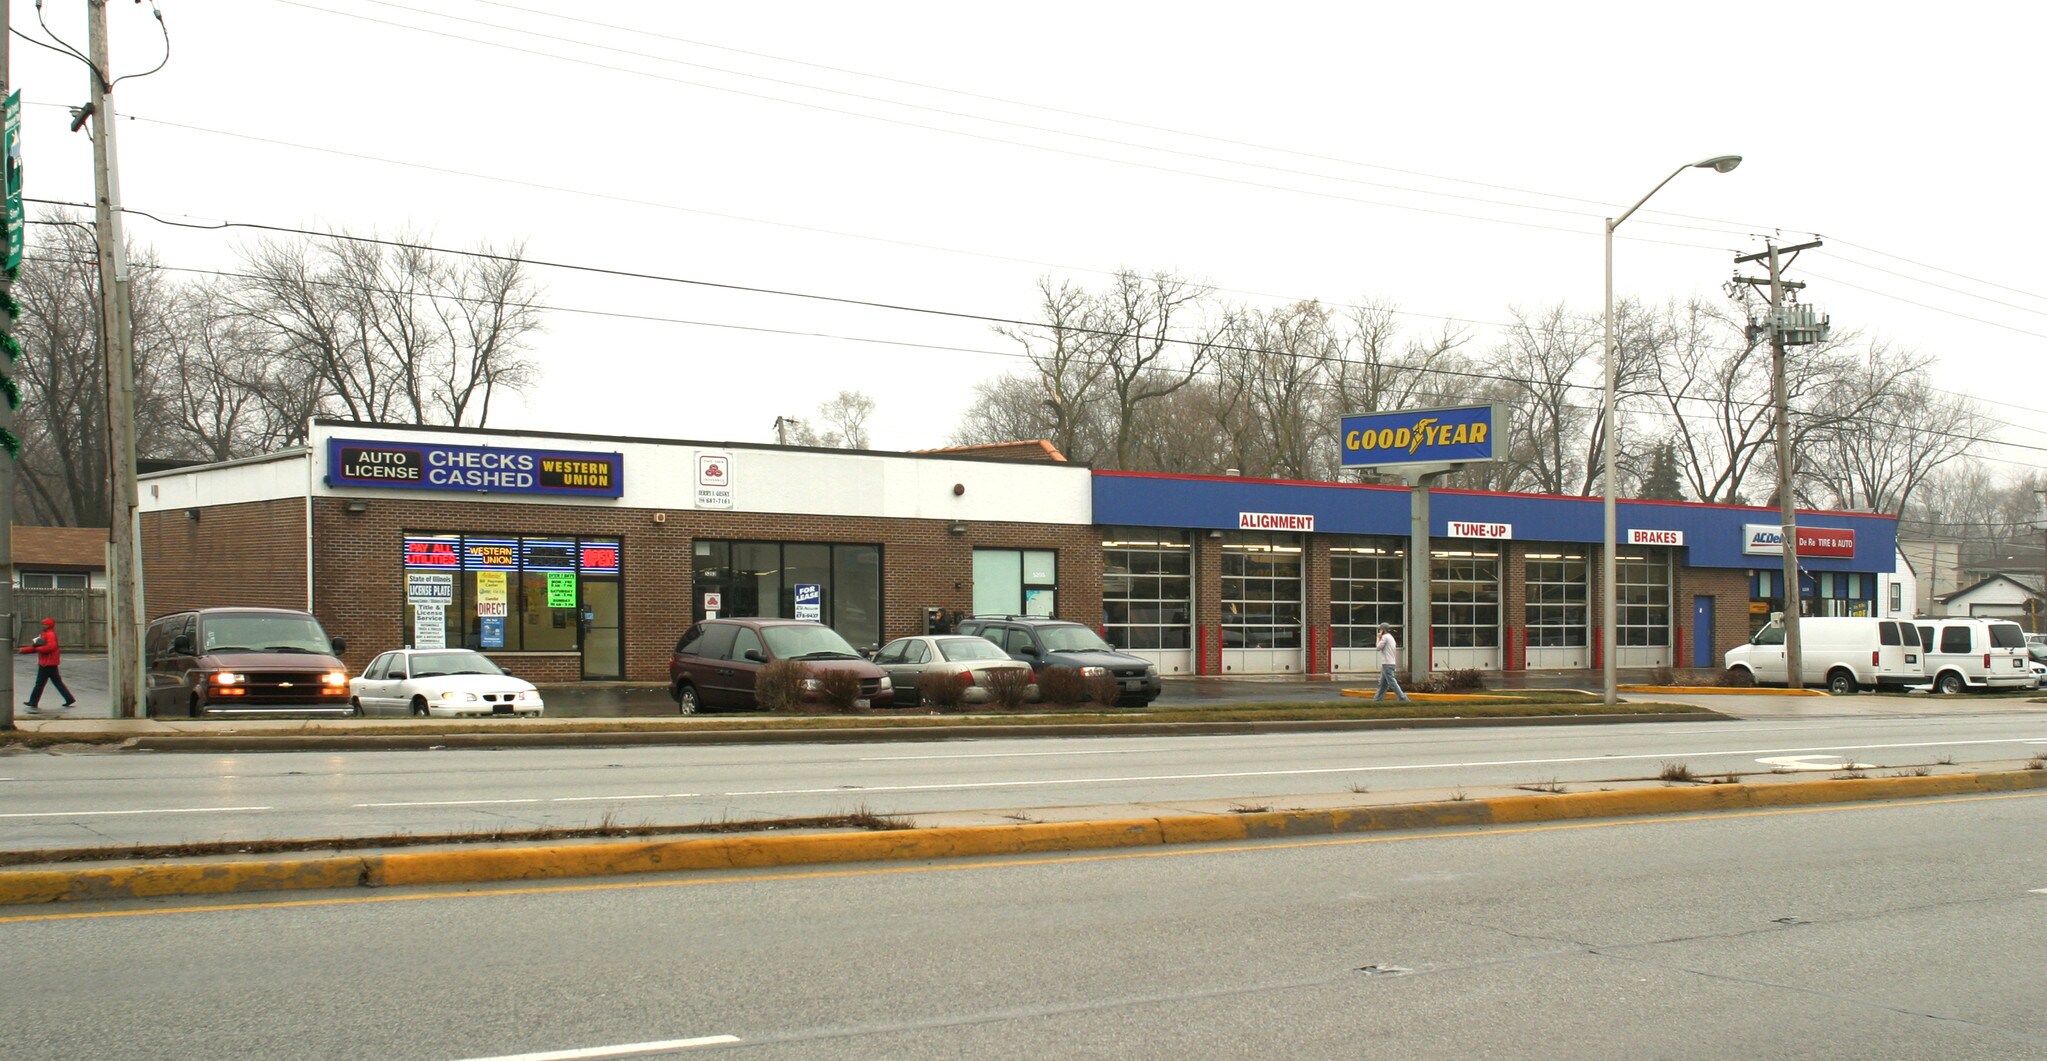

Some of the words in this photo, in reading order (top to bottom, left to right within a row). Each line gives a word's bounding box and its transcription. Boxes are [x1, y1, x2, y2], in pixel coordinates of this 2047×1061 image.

[1346, 422, 1488, 451] GOODYEAR
[358, 451, 407, 464] AUTO
[428, 451, 534, 470] CHECKS
[345, 464, 419, 479] LICENSE
[542, 461, 608, 474] WESTERN
[429, 469, 534, 488] CASHED
[563, 474, 608, 486] UNION
[1241, 514, 1312, 529] ALIGNMENT
[1453, 523, 1507, 537] TUNE-UP
[1634, 531, 1677, 544] BRAKES
[1752, 532, 1783, 544] ACDel
[1799, 538, 1808, 546] De
[1818, 538, 1831, 547] TIRE
[1832, 539, 1837, 547] &
[1838, 539, 1853, 548] AUTO
[408, 543, 429, 553] PAY
[433, 544, 454, 554] ALL
[469, 547, 513, 556] WESTERN
[407, 554, 457, 565] UTILITIES
[483, 556, 513, 564] UNION
[583, 549, 616, 567] OPEN
[409, 585, 432, 596] LICENSE
[433, 585, 451, 596] PLATE
[796, 591, 819, 601] LEASE
[799, 586, 815, 594] FOR
[479, 603, 505, 615] DIRECT
